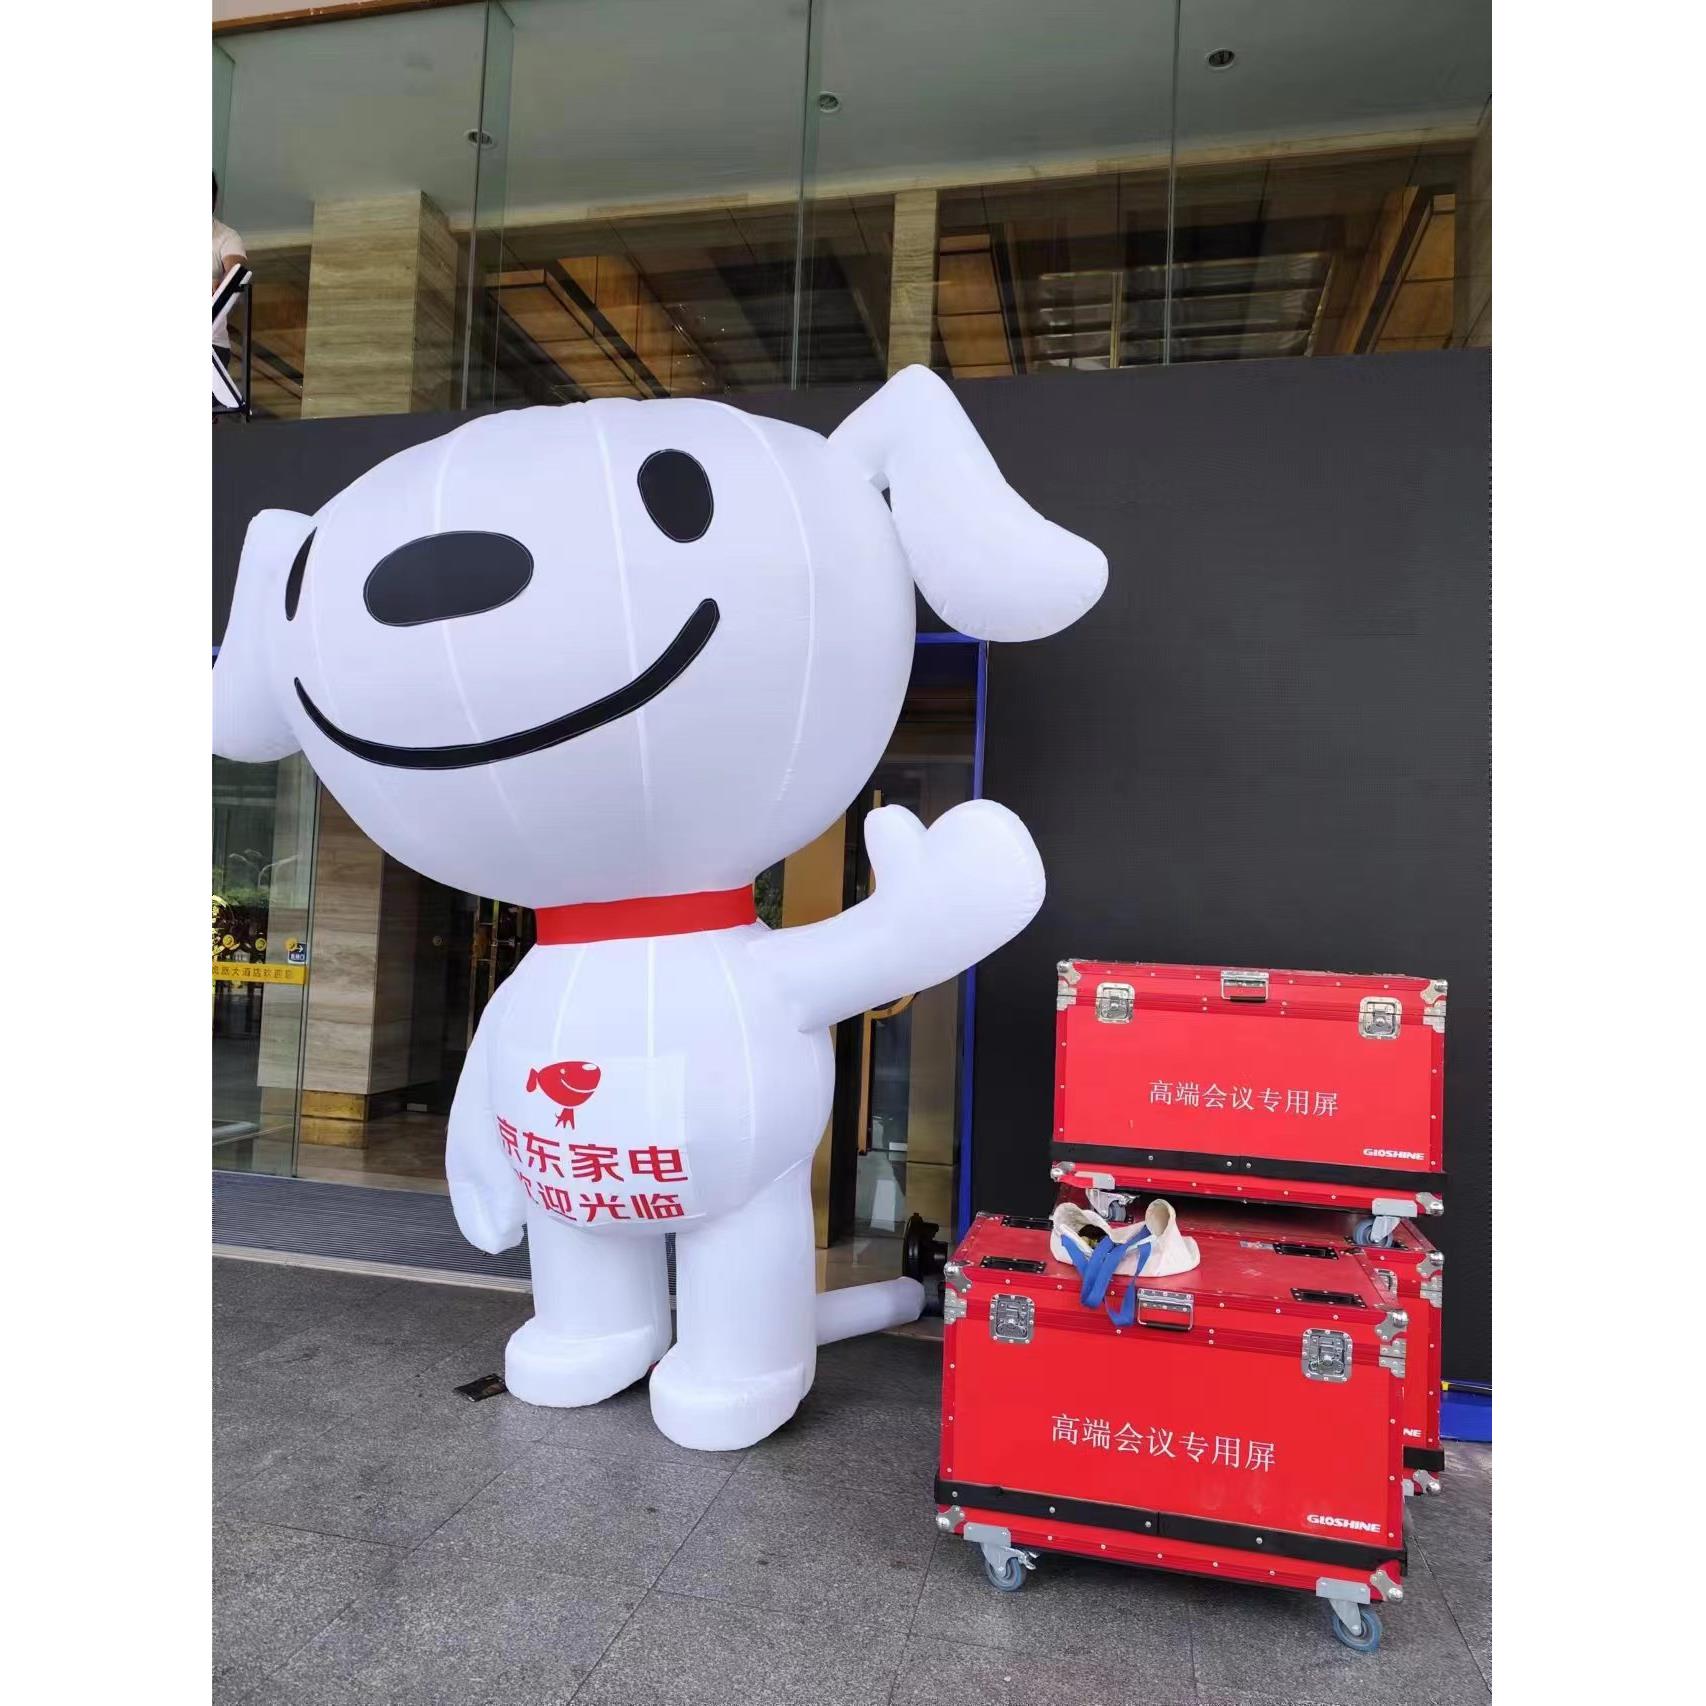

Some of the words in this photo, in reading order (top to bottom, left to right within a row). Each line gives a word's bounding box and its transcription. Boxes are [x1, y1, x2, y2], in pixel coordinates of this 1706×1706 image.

[1149, 1080, 1338, 1116] 高端会议专用屏
[497, 1115, 688, 1182] 京东家电
[1051, 1413, 1275, 1473] 高端会议专用屏
[1402, 1428, 1422, 1438] NE
